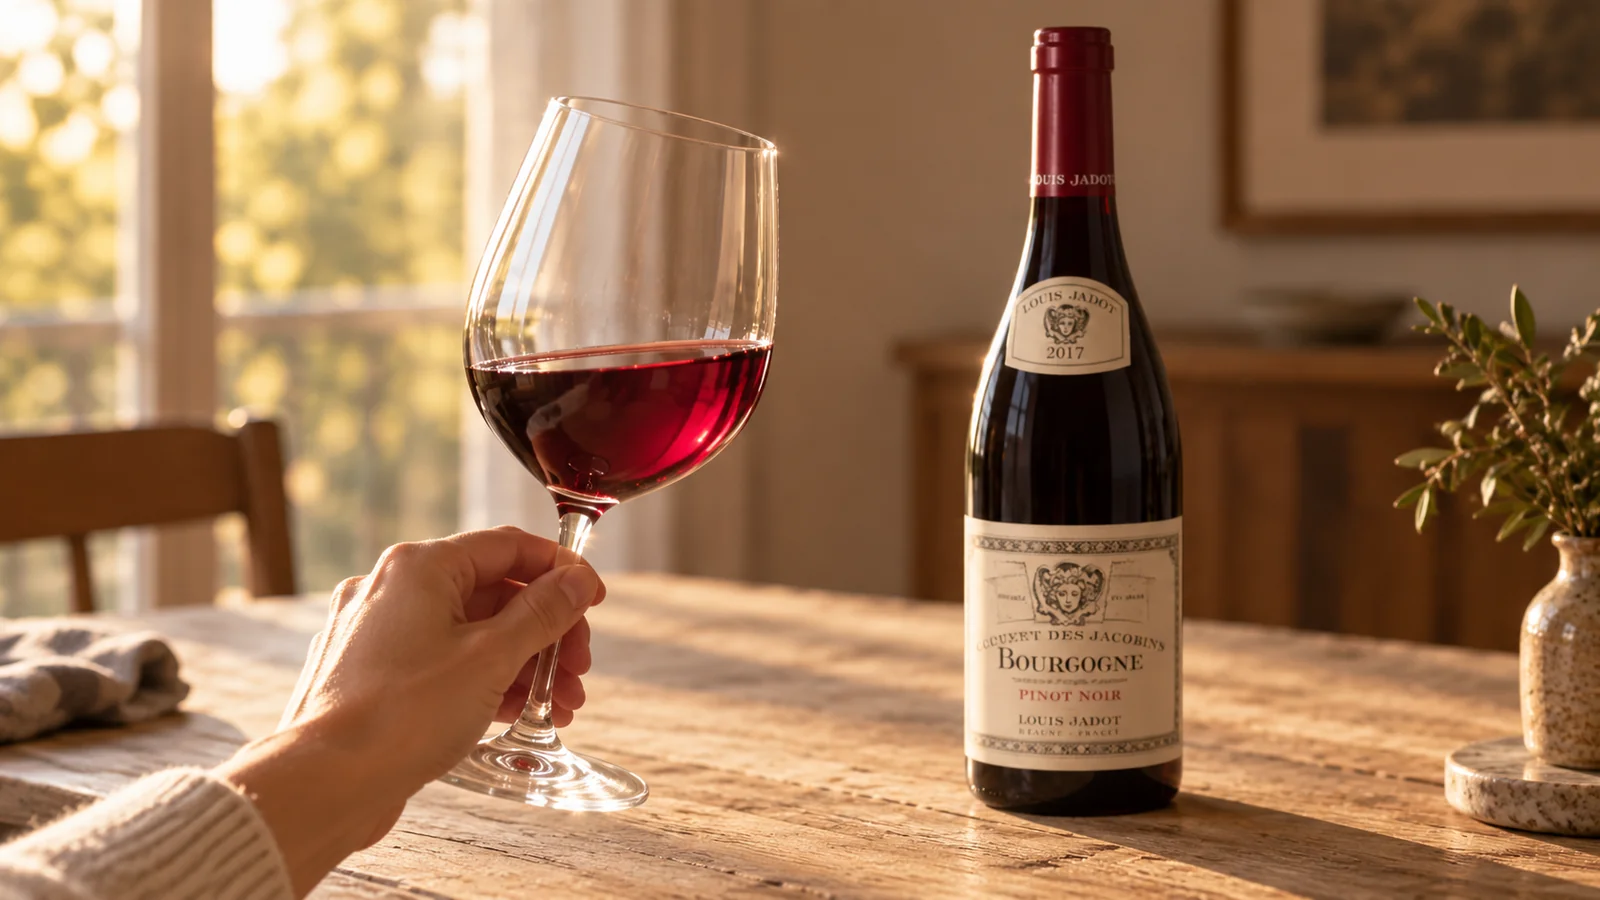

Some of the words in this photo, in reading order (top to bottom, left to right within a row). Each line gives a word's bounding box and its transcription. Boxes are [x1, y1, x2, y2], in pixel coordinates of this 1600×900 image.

[1033, 174, 1065, 186] OUIS
[1022, 291, 1062, 314] LOUIS
[1069, 290, 1117, 314] JADOT
[1046, 346, 1084, 359] 2017
[1048, 630, 1084, 641] DES
[1089, 630, 1165, 651] JACOBINS
[1019, 689, 1072, 702] PINOT
[1079, 689, 1122, 702] NOIR
[1018, 715, 1064, 727] LOUIS
[1069, 715, 1122, 727] JADOT
